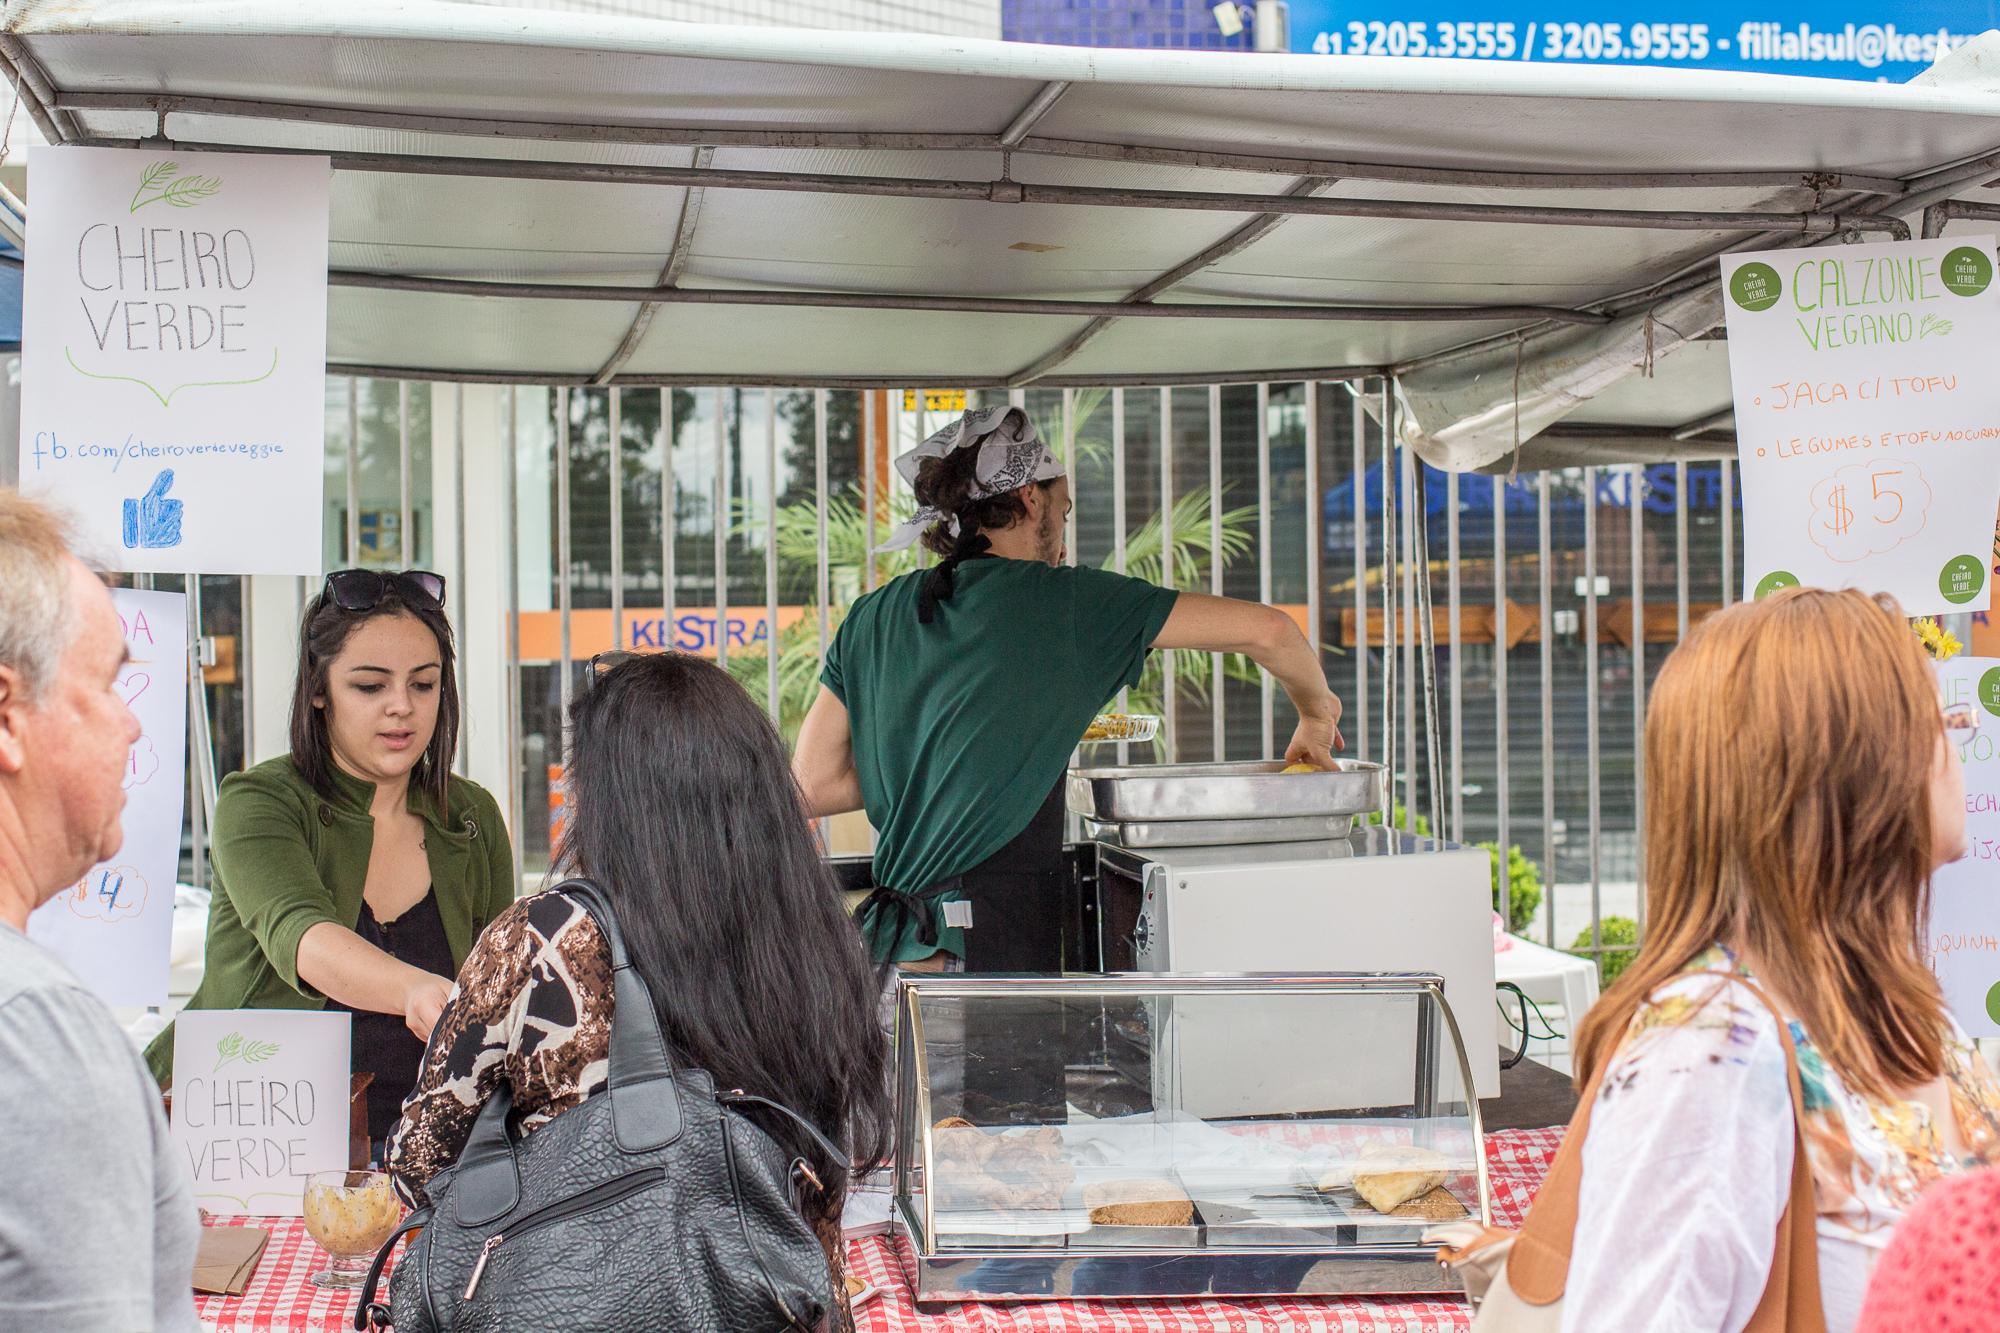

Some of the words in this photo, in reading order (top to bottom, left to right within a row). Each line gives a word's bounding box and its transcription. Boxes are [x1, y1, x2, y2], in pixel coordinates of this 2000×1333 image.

[1312, 32, 1342, 54] 41
[1347, 21, 1516, 57] 3205.3555
[1523, 22, 1537, 61] /
[1543, 22, 1709, 60] 3205.9555
[1737, 21, 1977, 68] filialsul@kestr
[78, 223, 255, 291] CHEIRO
[1793, 256, 1940, 312] CALZONE
[80, 297, 248, 353] VERDE
[1796, 312, 1912, 351] VEGANO
[1769, 381, 1848, 409] JACA
[1858, 376, 1880, 400] C/
[1889, 374, 1957, 396] TOFU
[31, 431, 284, 473] fb.com/cheiroverdeveggie
[1776, 435, 1872, 459] LEGUMES
[1823, 484, 1855, 536] $
[1872, 470, 1903, 524] 5
[185, 1137, 312, 1182] VERDE
